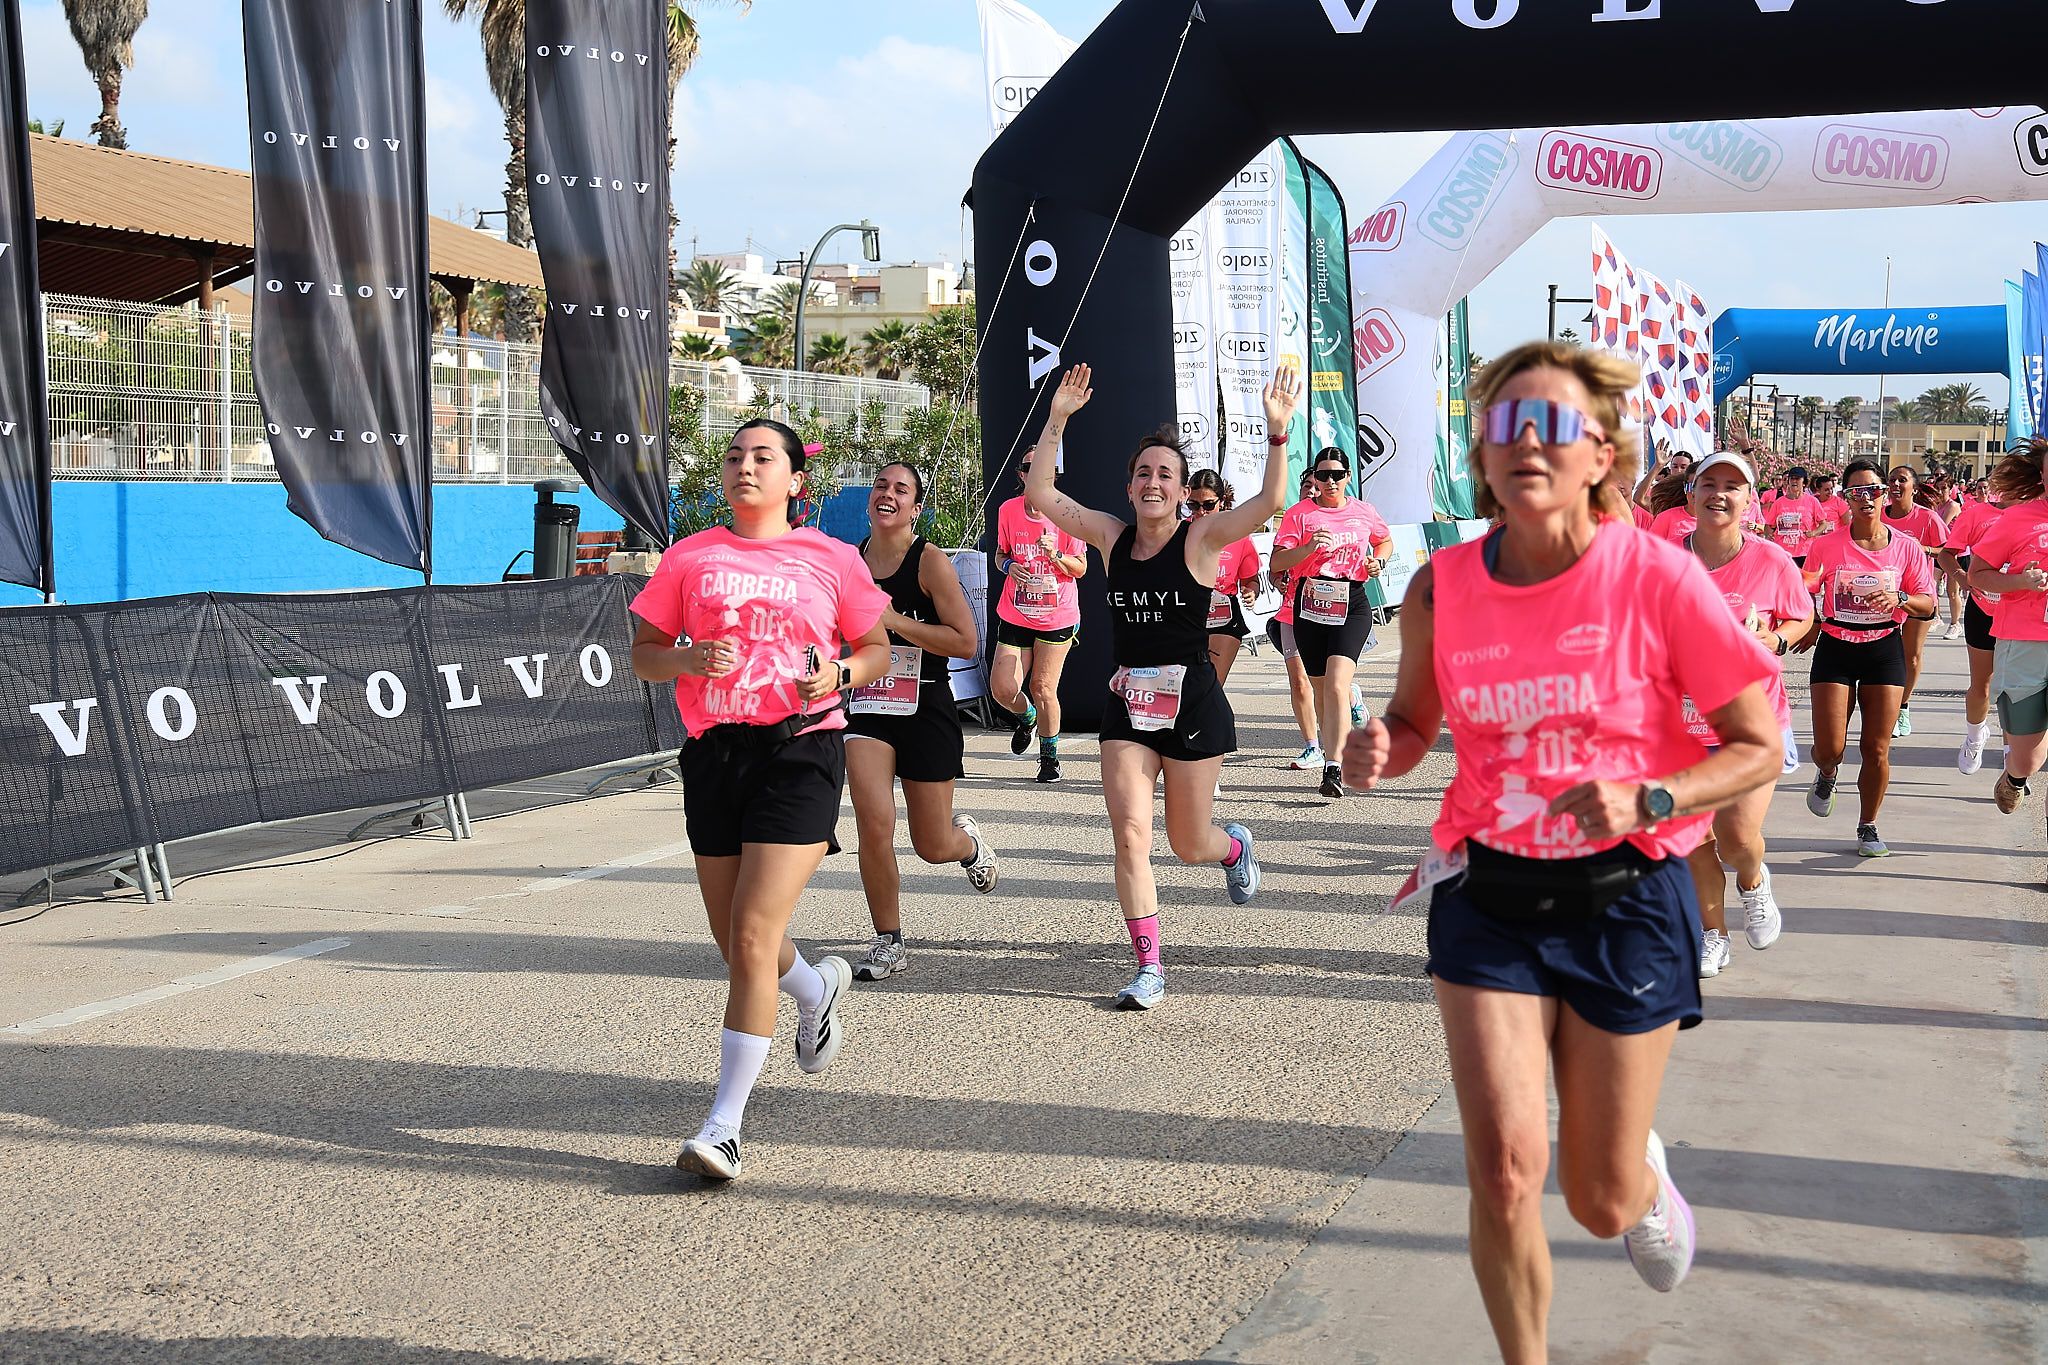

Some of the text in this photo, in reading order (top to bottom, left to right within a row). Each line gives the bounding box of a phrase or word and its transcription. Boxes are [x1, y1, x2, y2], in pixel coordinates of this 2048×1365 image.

[1547, 139, 1651, 193] COSMO
[1825, 132, 1938, 183] COSMO
[1427, 142, 1508, 240] COSMO
[1813, 313, 1939, 366] Marlene
[1027, 592, 1043, 600] 016
[1313, 599, 1332, 608] 016
[1125, 611, 1163, 622] LIFE
[1452, 643, 1510, 666] OYSHO
[273, 643, 613, 725] VOLVO
[1125, 689, 1155, 704] 016
